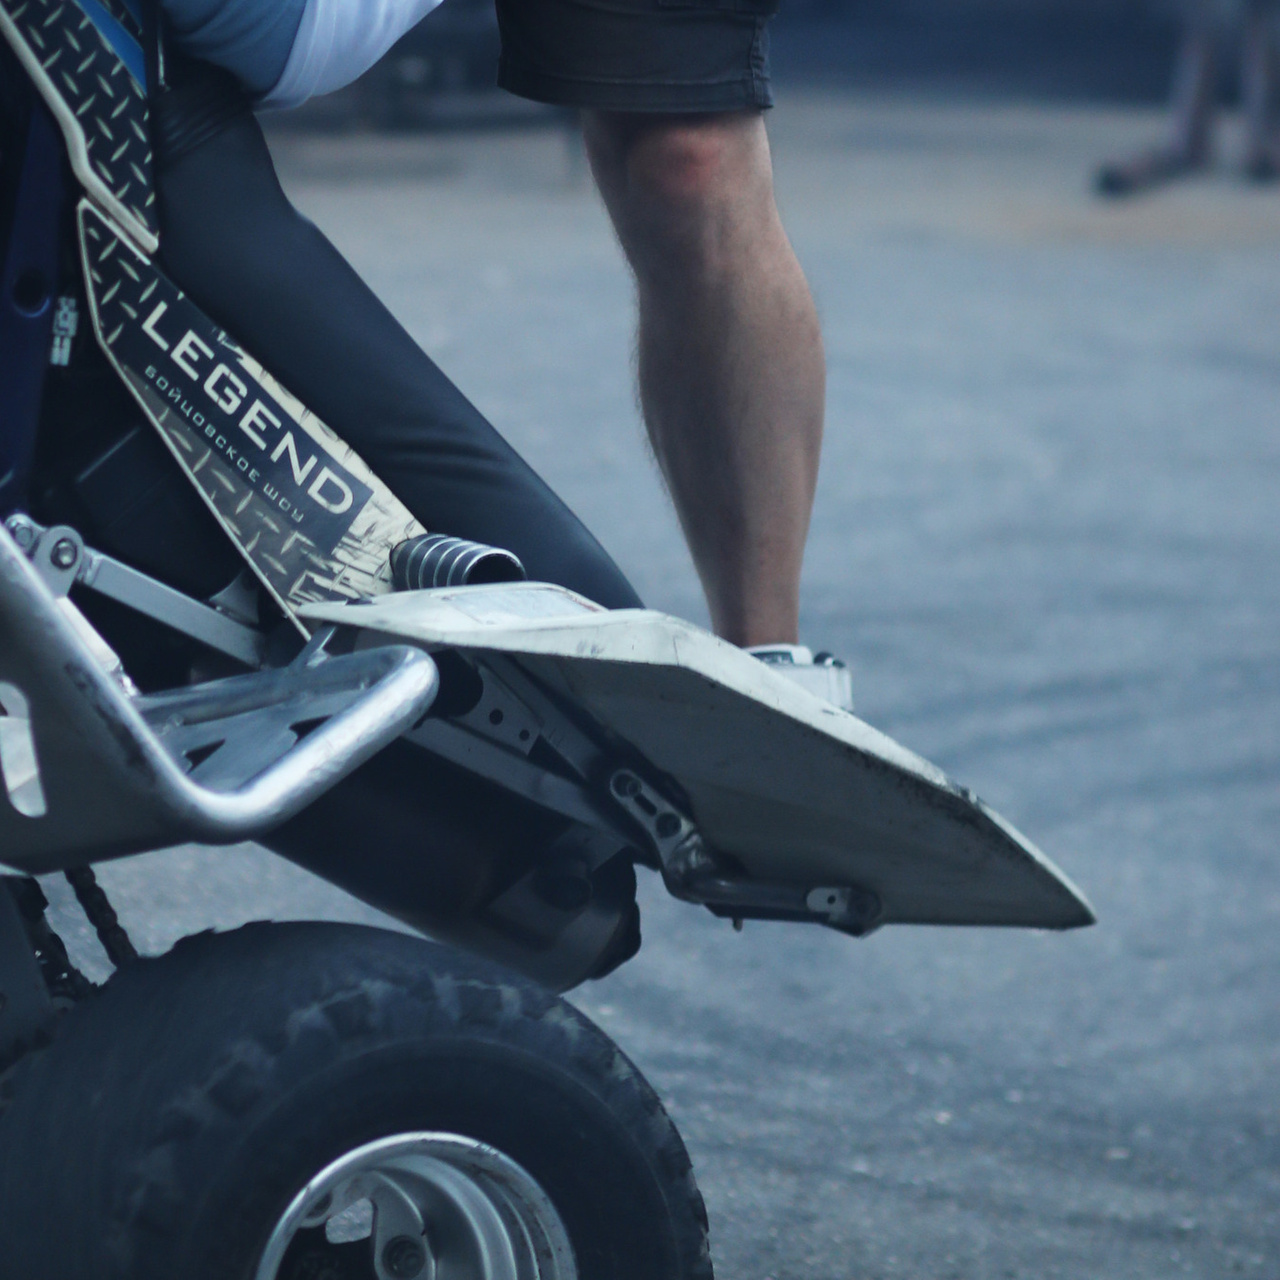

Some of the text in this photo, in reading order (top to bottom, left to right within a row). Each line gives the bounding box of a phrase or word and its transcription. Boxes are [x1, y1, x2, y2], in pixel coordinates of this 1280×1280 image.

[141, 300, 354, 515] LEGEND
[144, 365, 304, 523] БОЙЦОВСКОЕ ШОУ
